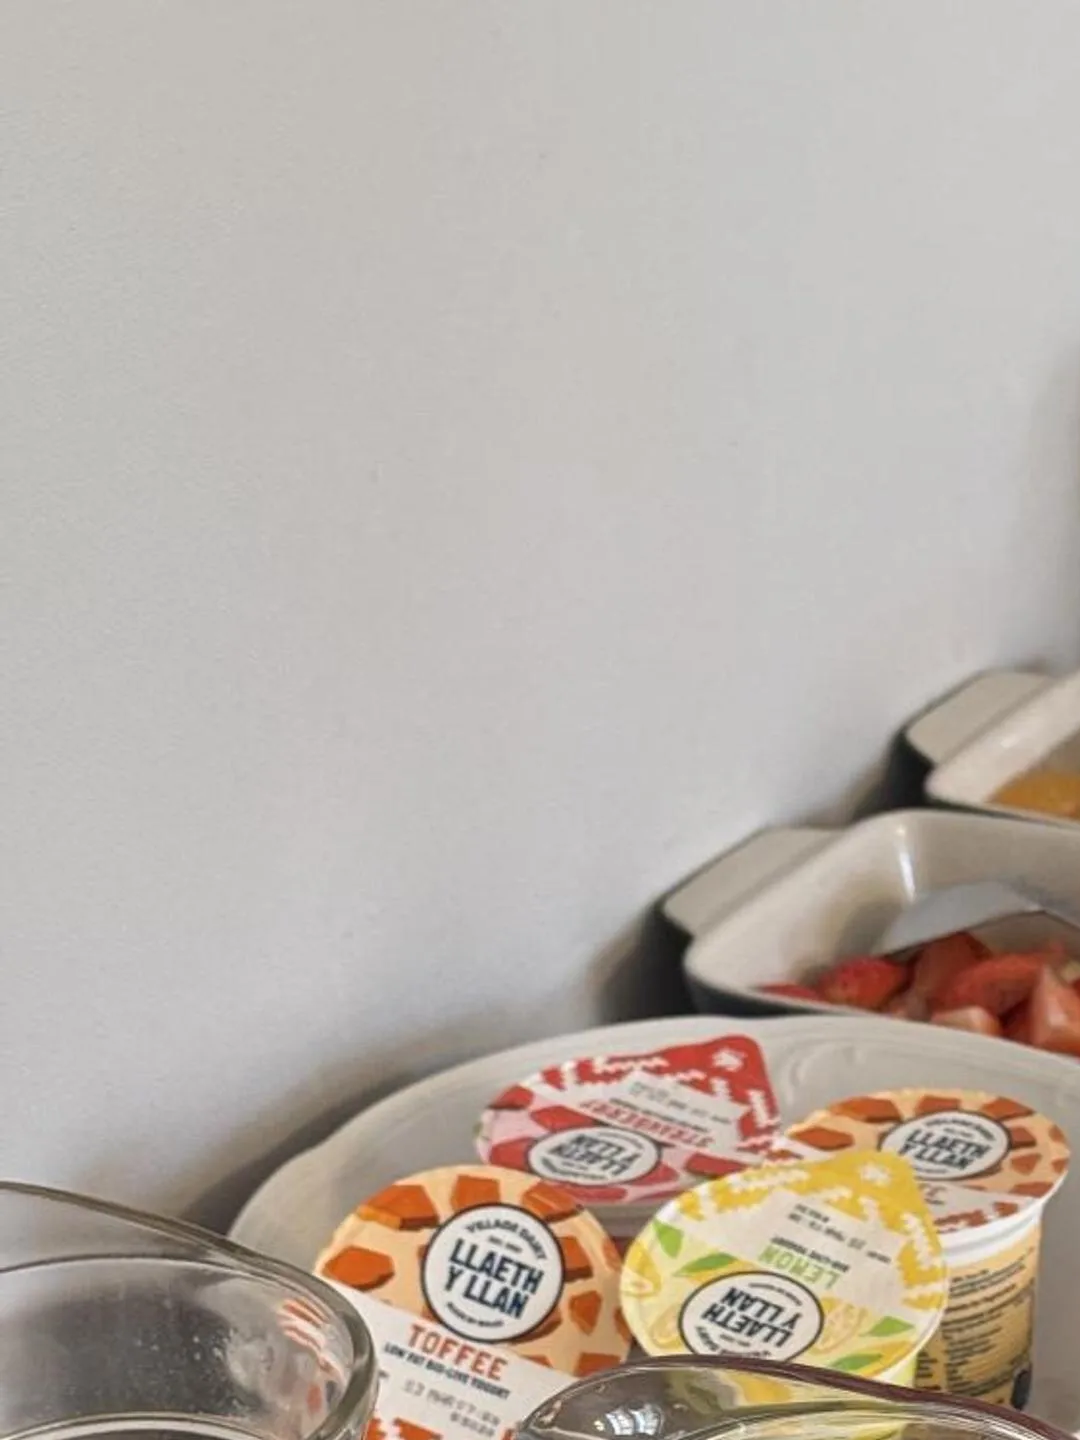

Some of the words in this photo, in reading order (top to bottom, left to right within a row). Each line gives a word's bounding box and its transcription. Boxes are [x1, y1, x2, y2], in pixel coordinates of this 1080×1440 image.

[449, 1238, 544, 1294] LLAETH
[759, 1246, 839, 1289] LEMON
[445, 1267, 460, 1292] Y
[463, 1280, 529, 1319] LLAN
[721, 1286, 785, 1317] LLAN
[701, 1302, 793, 1347] LLAETH
[782, 1313, 801, 1329] Y
[409, 1324, 508, 1381] TOFFEE
